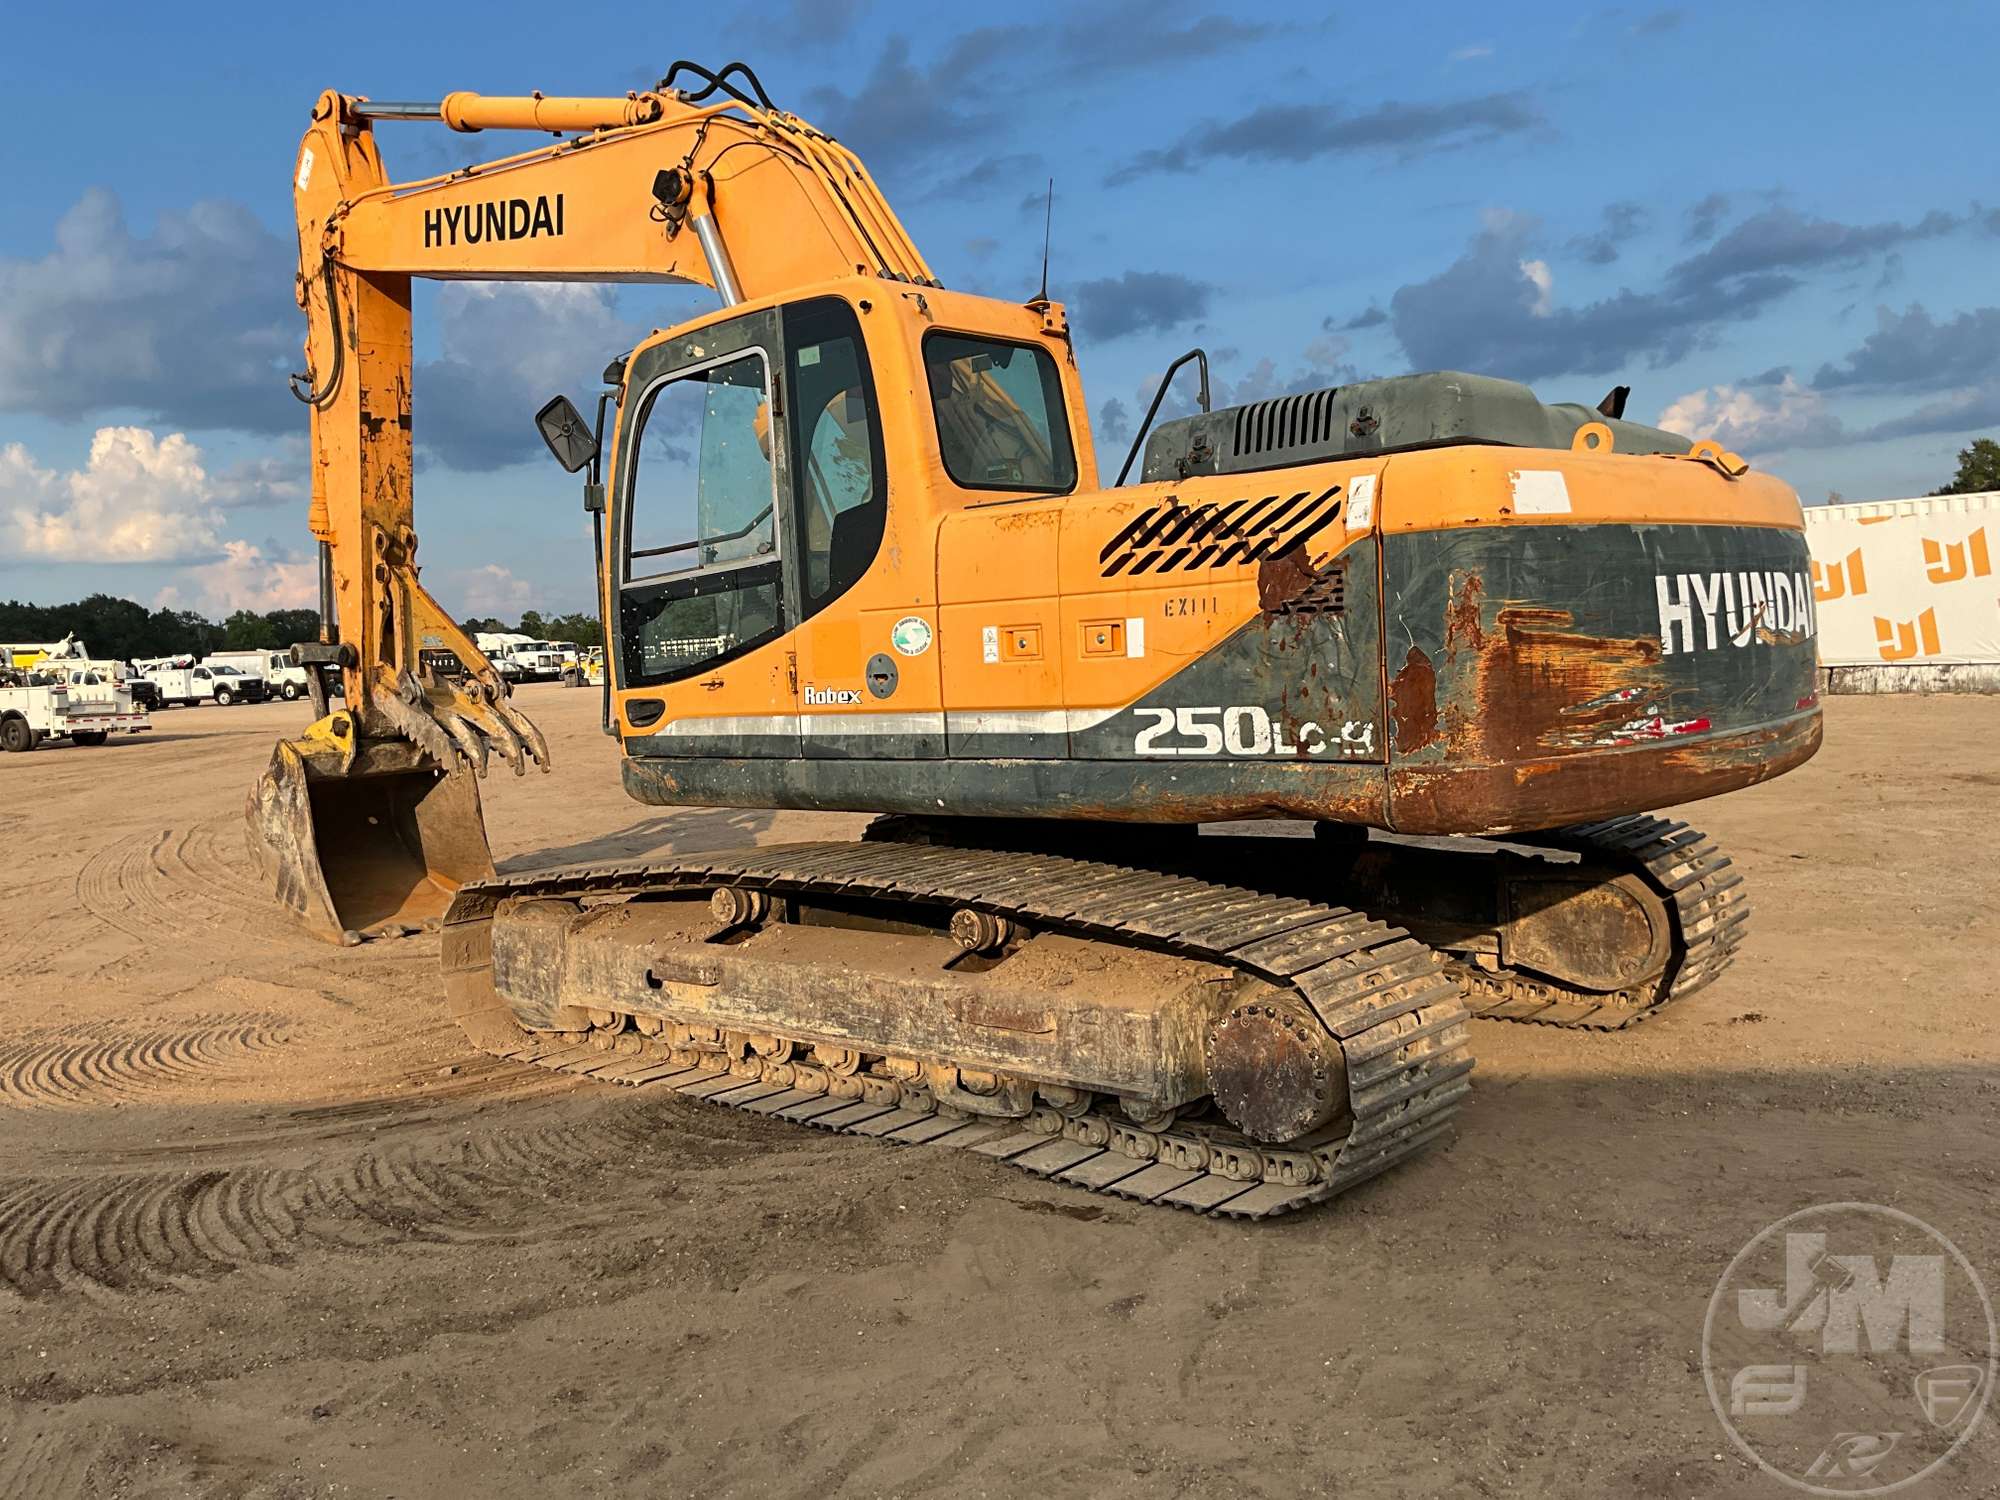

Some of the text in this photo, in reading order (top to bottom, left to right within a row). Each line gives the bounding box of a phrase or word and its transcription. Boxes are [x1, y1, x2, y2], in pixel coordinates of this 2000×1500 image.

[425, 193, 564, 248] HYUNDAI
[1655, 571, 1815, 655] HYUNDAI
[804, 686, 863, 704] Robex
